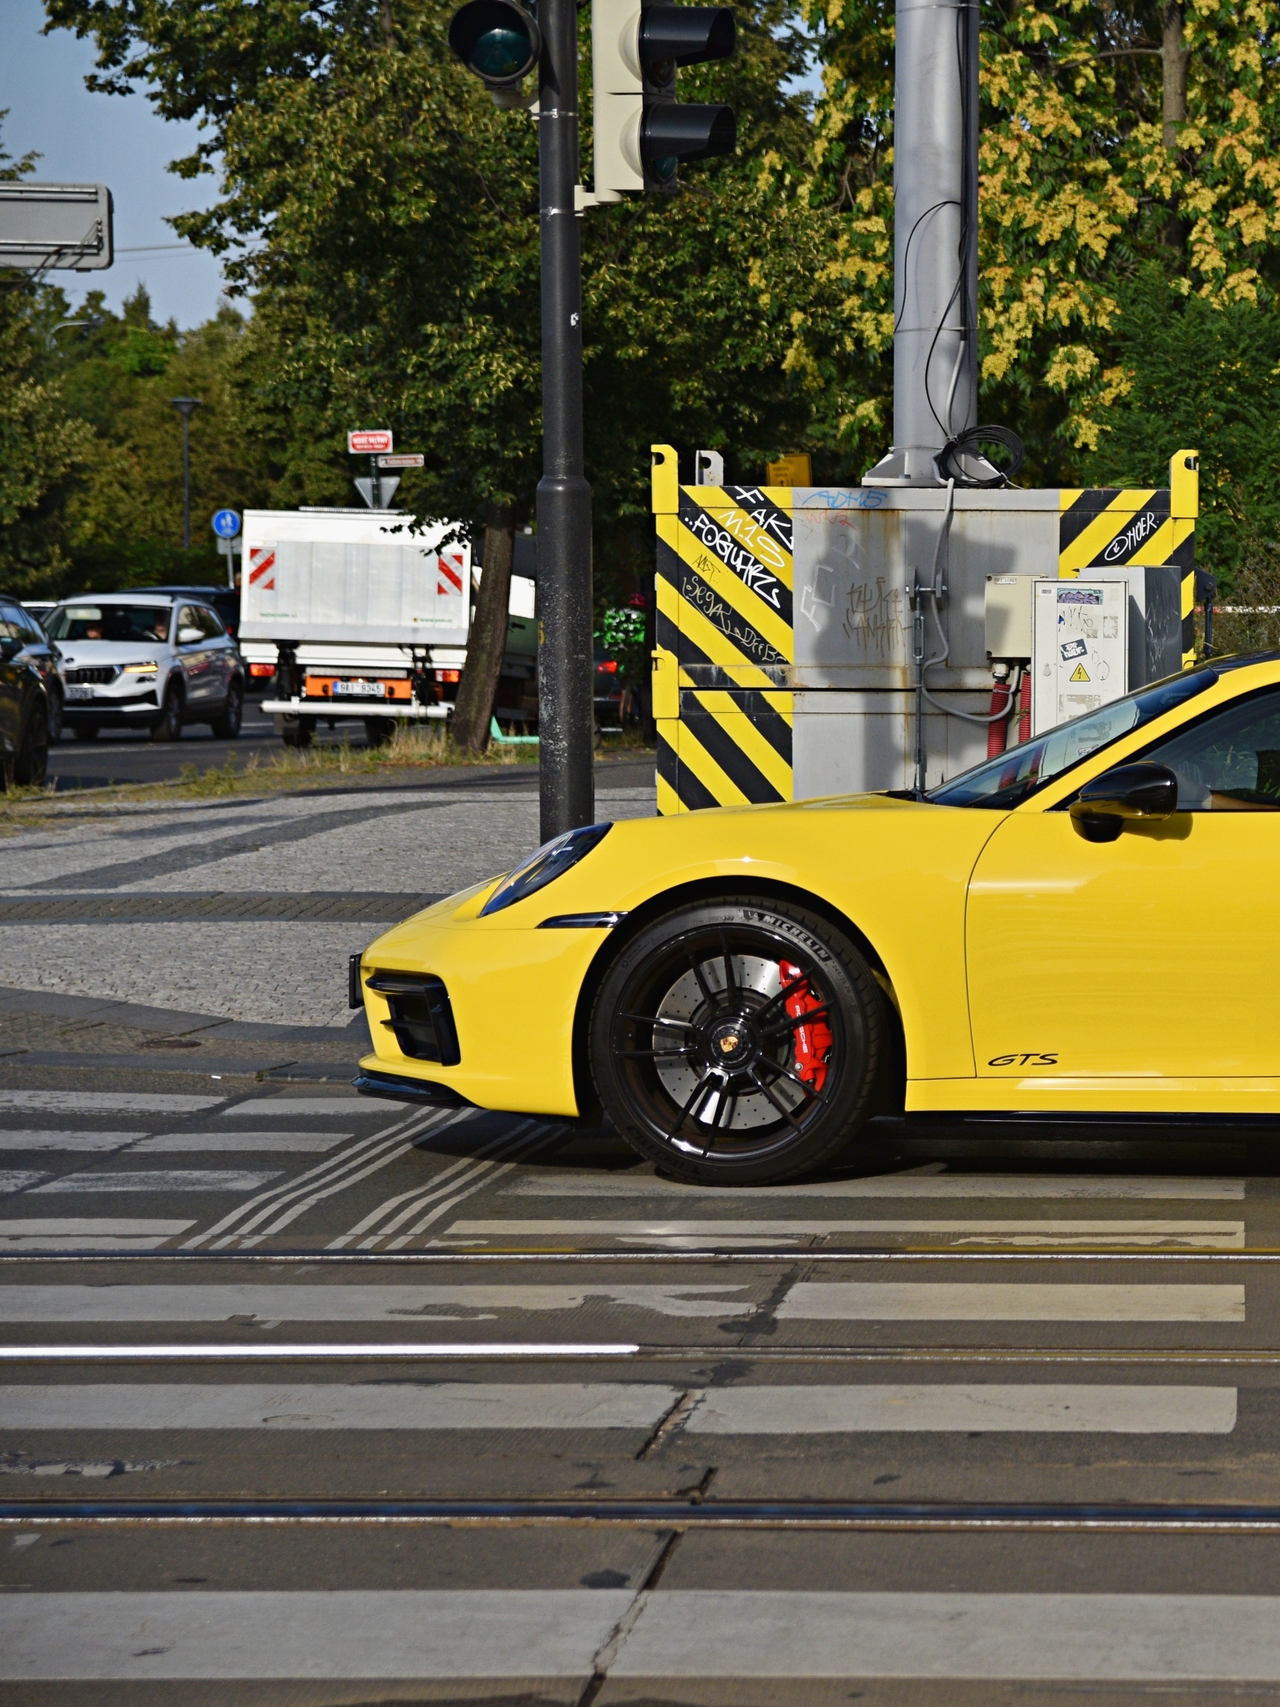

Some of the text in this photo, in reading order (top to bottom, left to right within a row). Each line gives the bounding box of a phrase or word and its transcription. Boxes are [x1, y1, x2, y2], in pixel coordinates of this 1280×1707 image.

[762, 915, 829, 960] MICHELIN
[795, 1004, 809, 1054] POSCHE
[987, 1053, 1059, 1067] GTS
